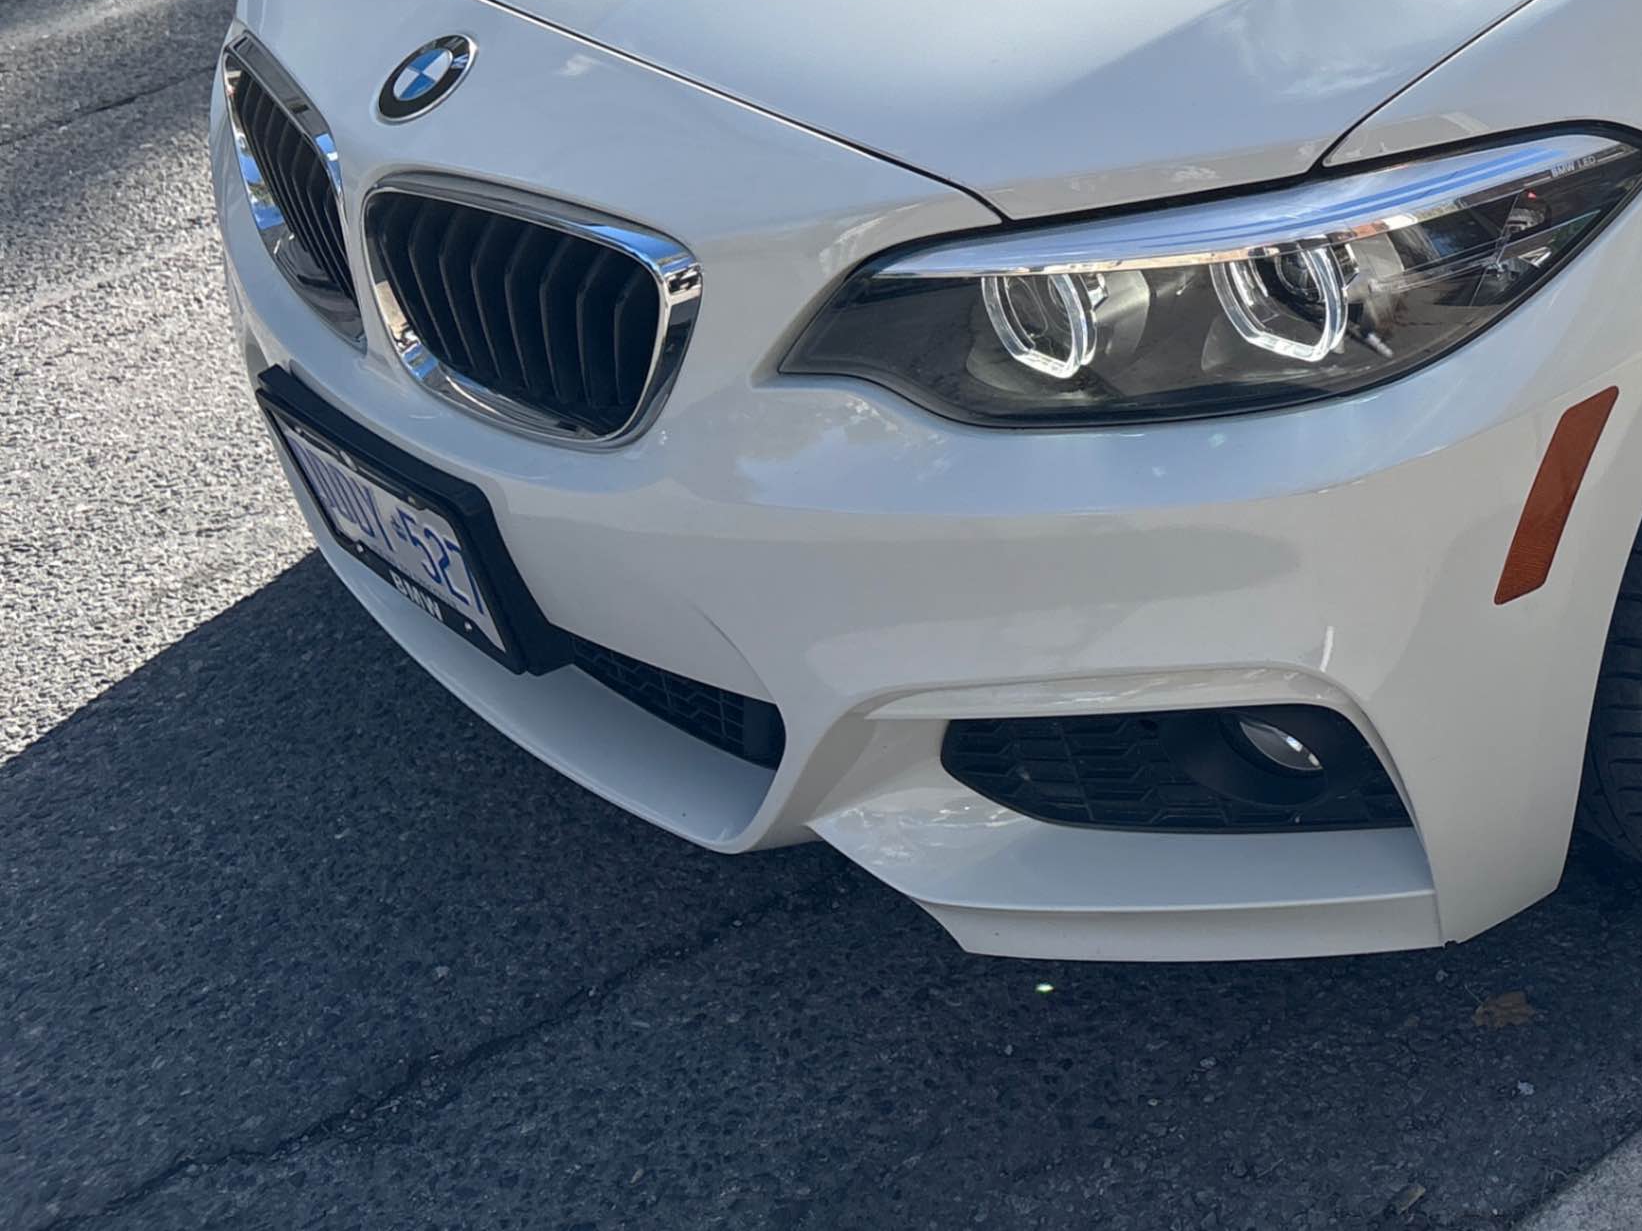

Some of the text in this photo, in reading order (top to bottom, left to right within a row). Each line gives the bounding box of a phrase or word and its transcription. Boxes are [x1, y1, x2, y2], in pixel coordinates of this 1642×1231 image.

[1549, 155, 1597, 178] BMW LED
[396, 507, 485, 616] 527
[389, 569, 443, 621] BMW
